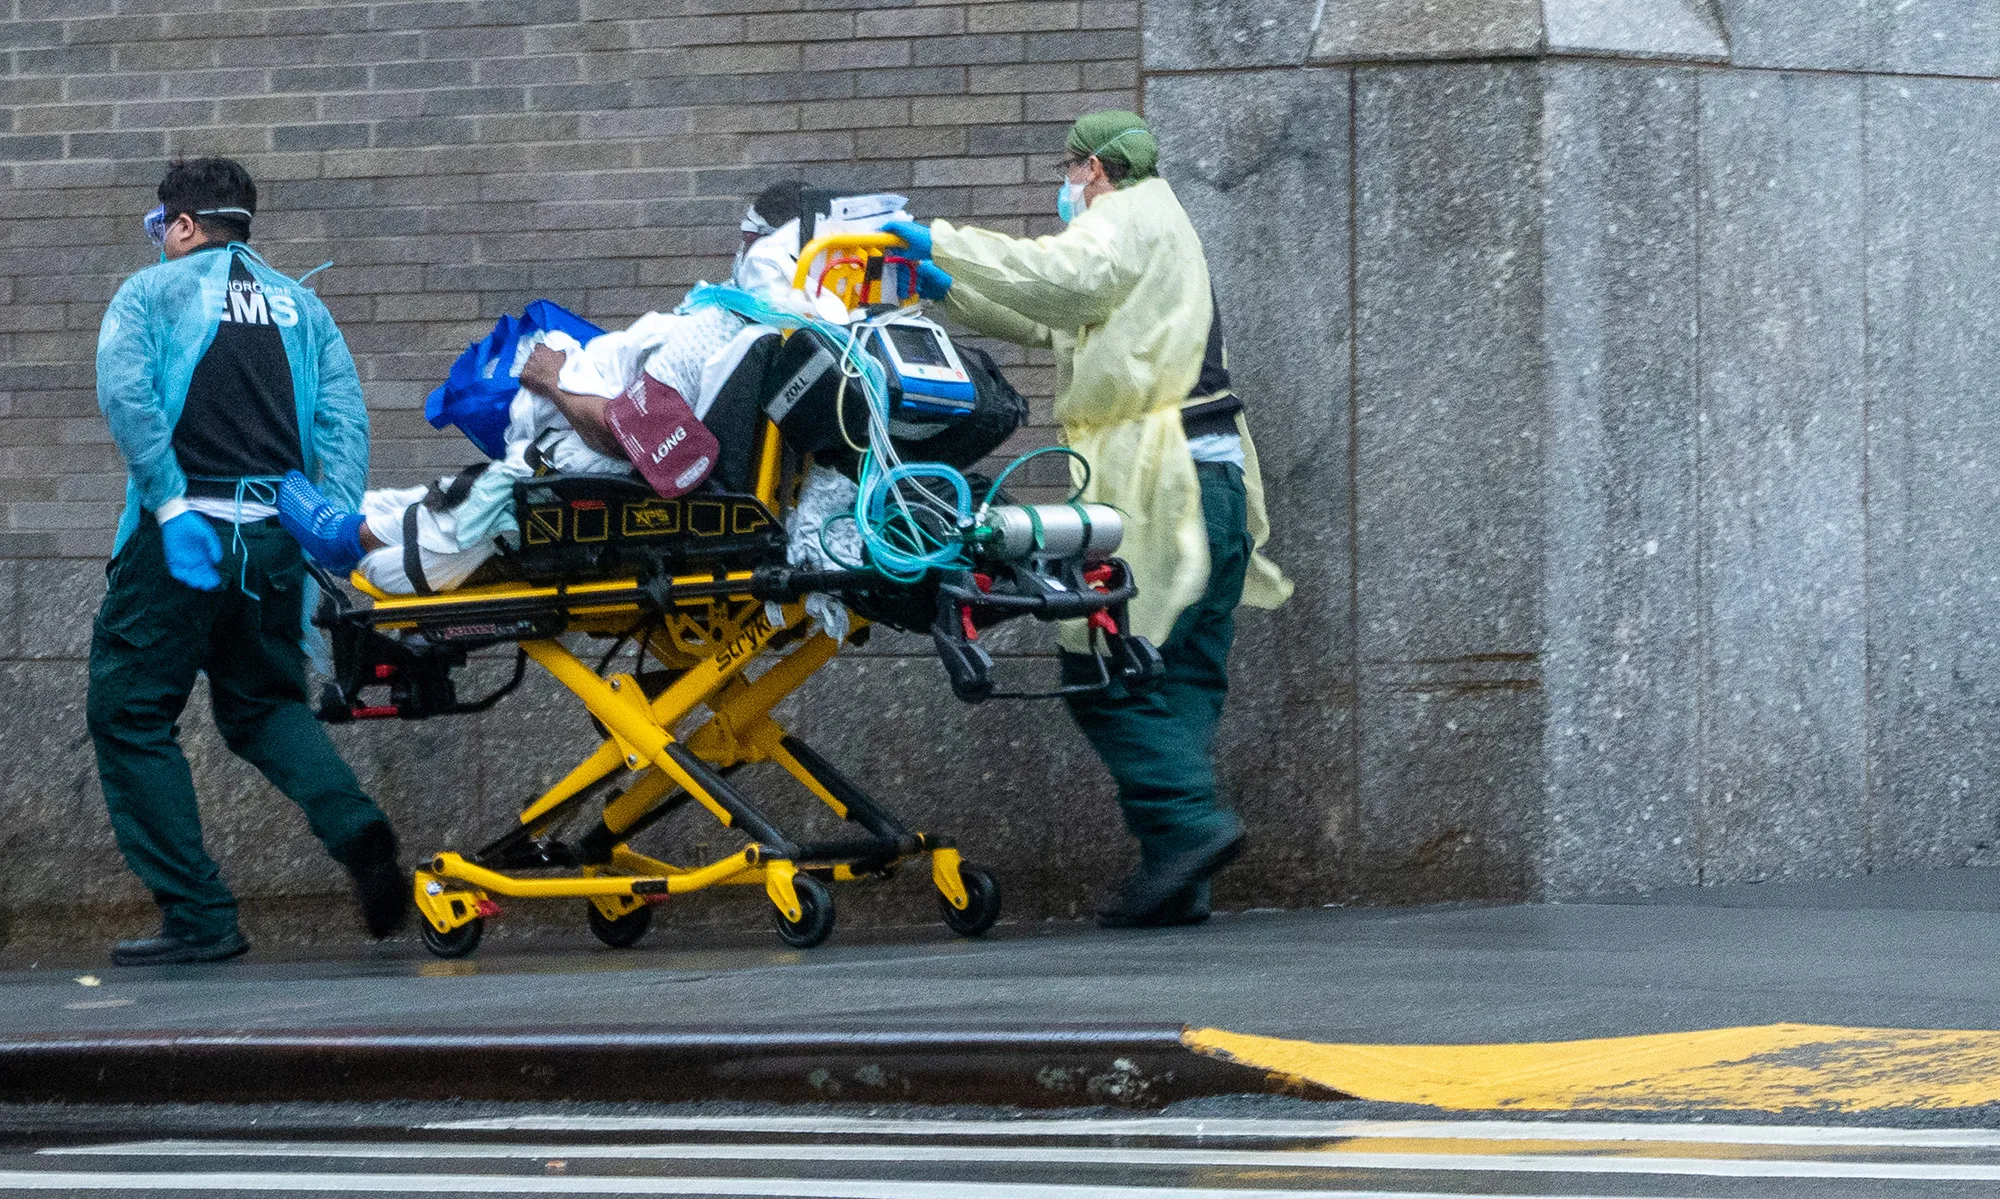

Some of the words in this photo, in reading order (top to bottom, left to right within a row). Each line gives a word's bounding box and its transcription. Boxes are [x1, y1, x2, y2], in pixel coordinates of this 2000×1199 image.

[203, 289, 299, 327] EMS
[785, 375, 810, 403] ZOLL
[651, 425, 687, 465] LONG
[632, 509, 669, 527] XPS
